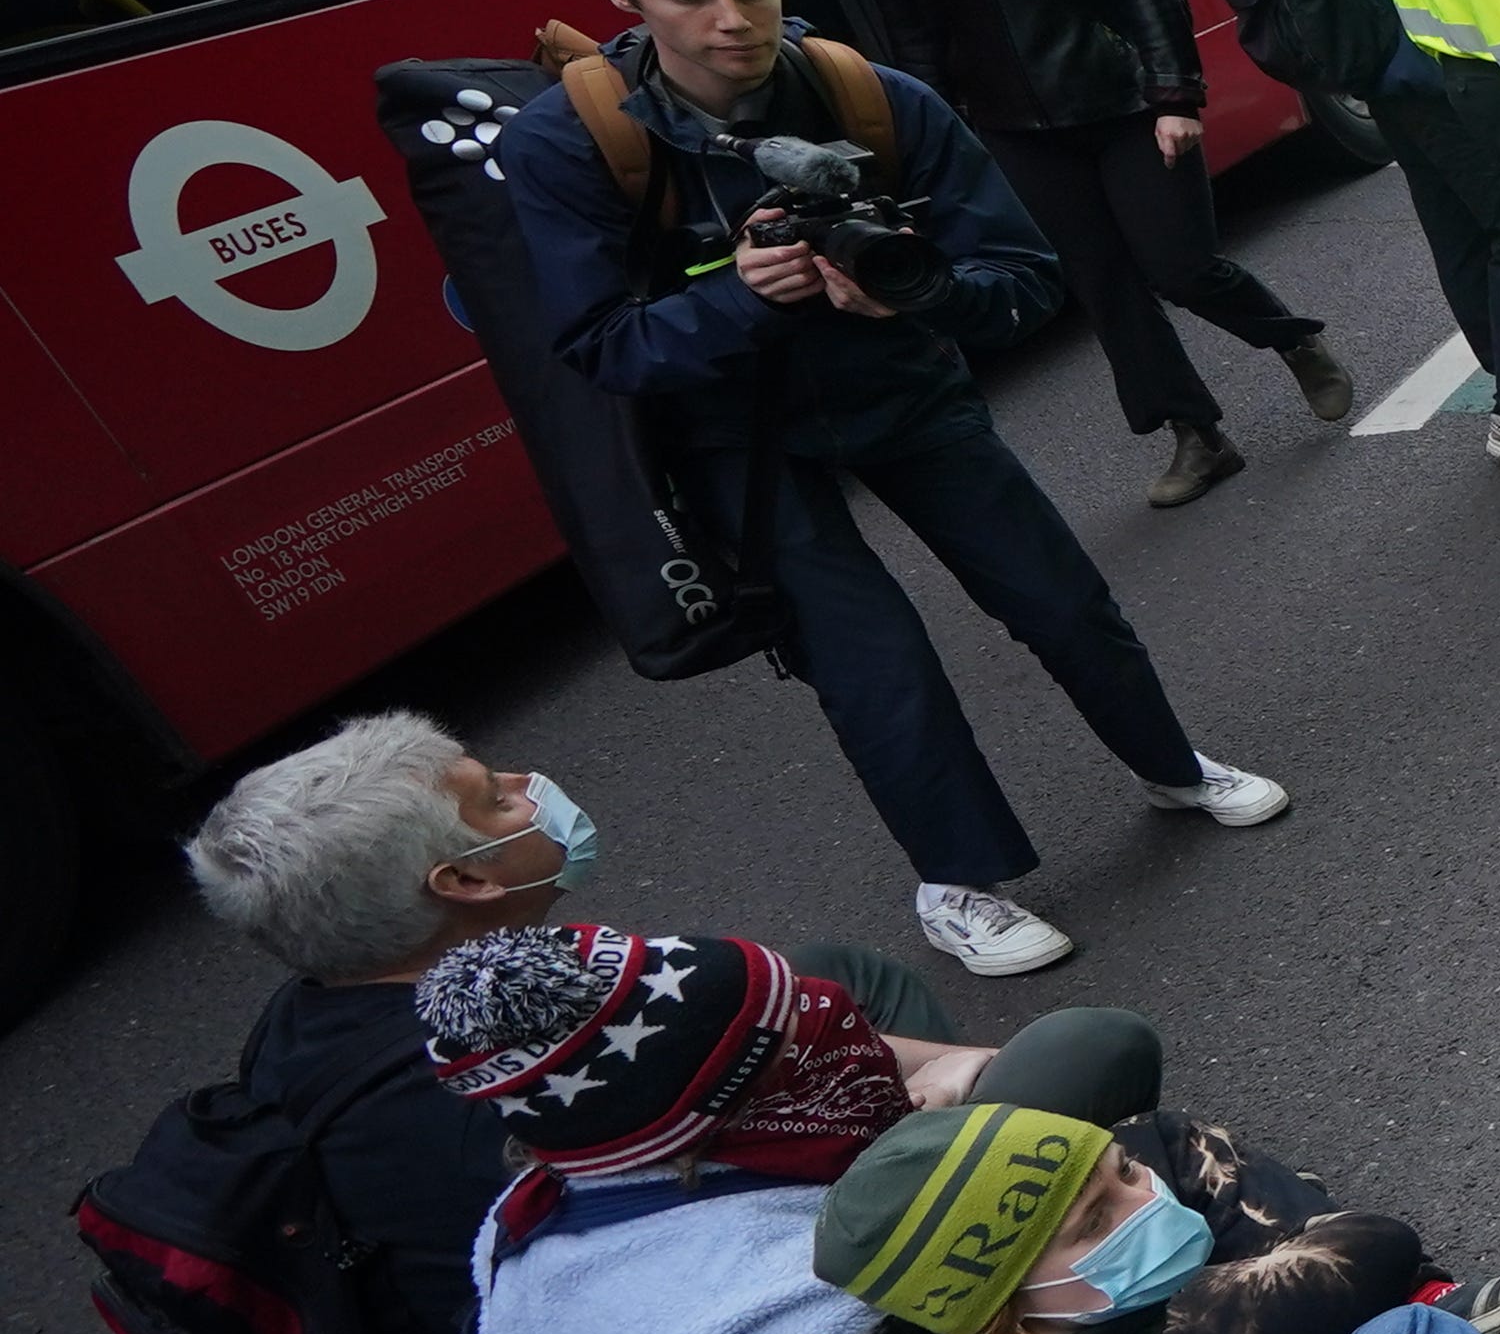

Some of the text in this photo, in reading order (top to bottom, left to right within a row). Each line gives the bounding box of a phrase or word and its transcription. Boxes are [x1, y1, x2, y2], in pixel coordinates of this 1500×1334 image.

[208, 212, 308, 264] BUSES
[219, 521, 307, 571] LONDON
[306, 484, 386, 529] GENERAL
[382, 438, 477, 491] TRANSPORT
[270, 549, 294, 569] 18
[292, 513, 369, 560] MERTON
[368, 492, 412, 522] HIGH
[411, 463, 468, 500] STREET
[653, 509, 688, 554] sachtler
[246, 554, 331, 605] LONDON
[260, 569, 347, 621] SW19 1DN
[660, 559, 717, 625] ace
[492, 1053, 525, 1076] IS
[937, 1134, 1070, 1284] Rab
